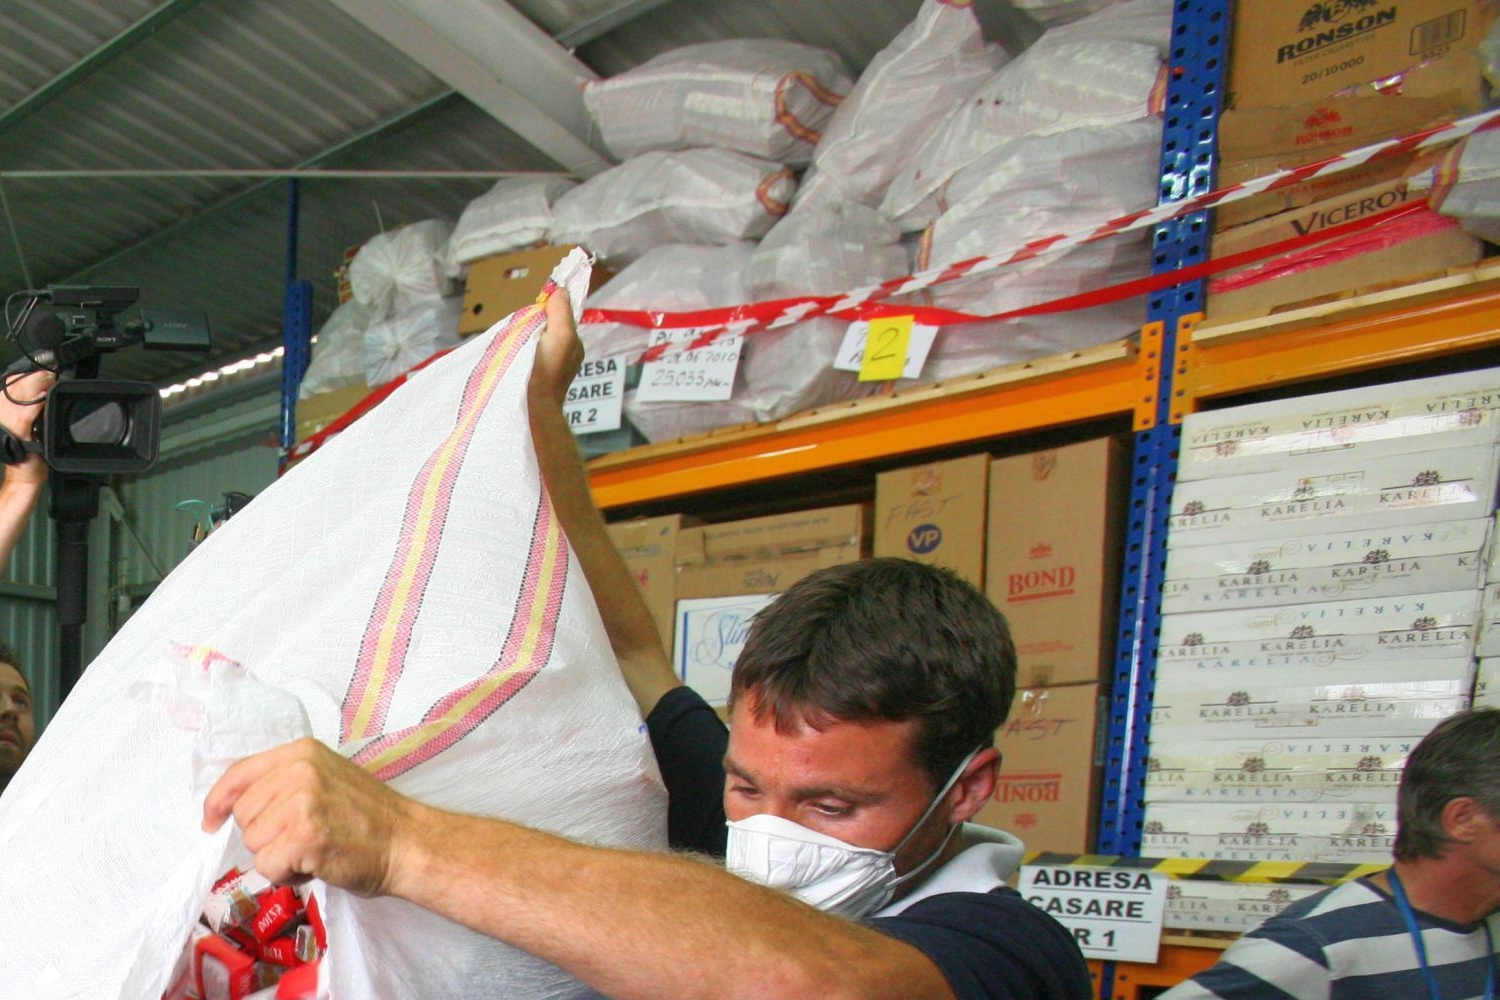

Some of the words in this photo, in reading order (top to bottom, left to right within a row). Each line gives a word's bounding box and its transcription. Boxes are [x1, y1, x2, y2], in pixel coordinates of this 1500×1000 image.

[1276, 6, 1397, 65] RONSON
[1290, 180, 1410, 236] VICEROY
[870, 327, 899, 362] 2
[567, 382, 613, 402] SARE
[587, 408, 597, 423] 2
[1302, 409, 1390, 429] KARELIA
[1261, 499, 1345, 518] KARELIA
[910, 530, 940, 549] VP
[1307, 532, 1434, 552] KARELIA
[1008, 566, 1076, 596] BOND
[1218, 573, 1299, 588] KARELIA
[1300, 603, 1426, 620] KARELIA
[1260, 638, 1344, 652] KARELIA
[1378, 630, 1471, 645] KARELIA
[1199, 706, 1277, 719] KARELIA
[1309, 702, 1396, 715] KARELIA
[1000, 717, 1078, 741] AST
[1212, 773, 1293, 783] KARELIA
[1325, 772, 1401, 783] KARELI
[994, 781, 1061, 803] BOND
[1185, 788, 1298, 797] KARELIA
[1218, 836, 1298, 847] KARELIA
[1329, 836, 1395, 848] KAREL
[1032, 869, 1153, 891] ADRESA
[257, 903, 283, 934] DOINA
[1173, 913, 1250, 925] KAREL
[1102, 930, 1115, 948] 1
